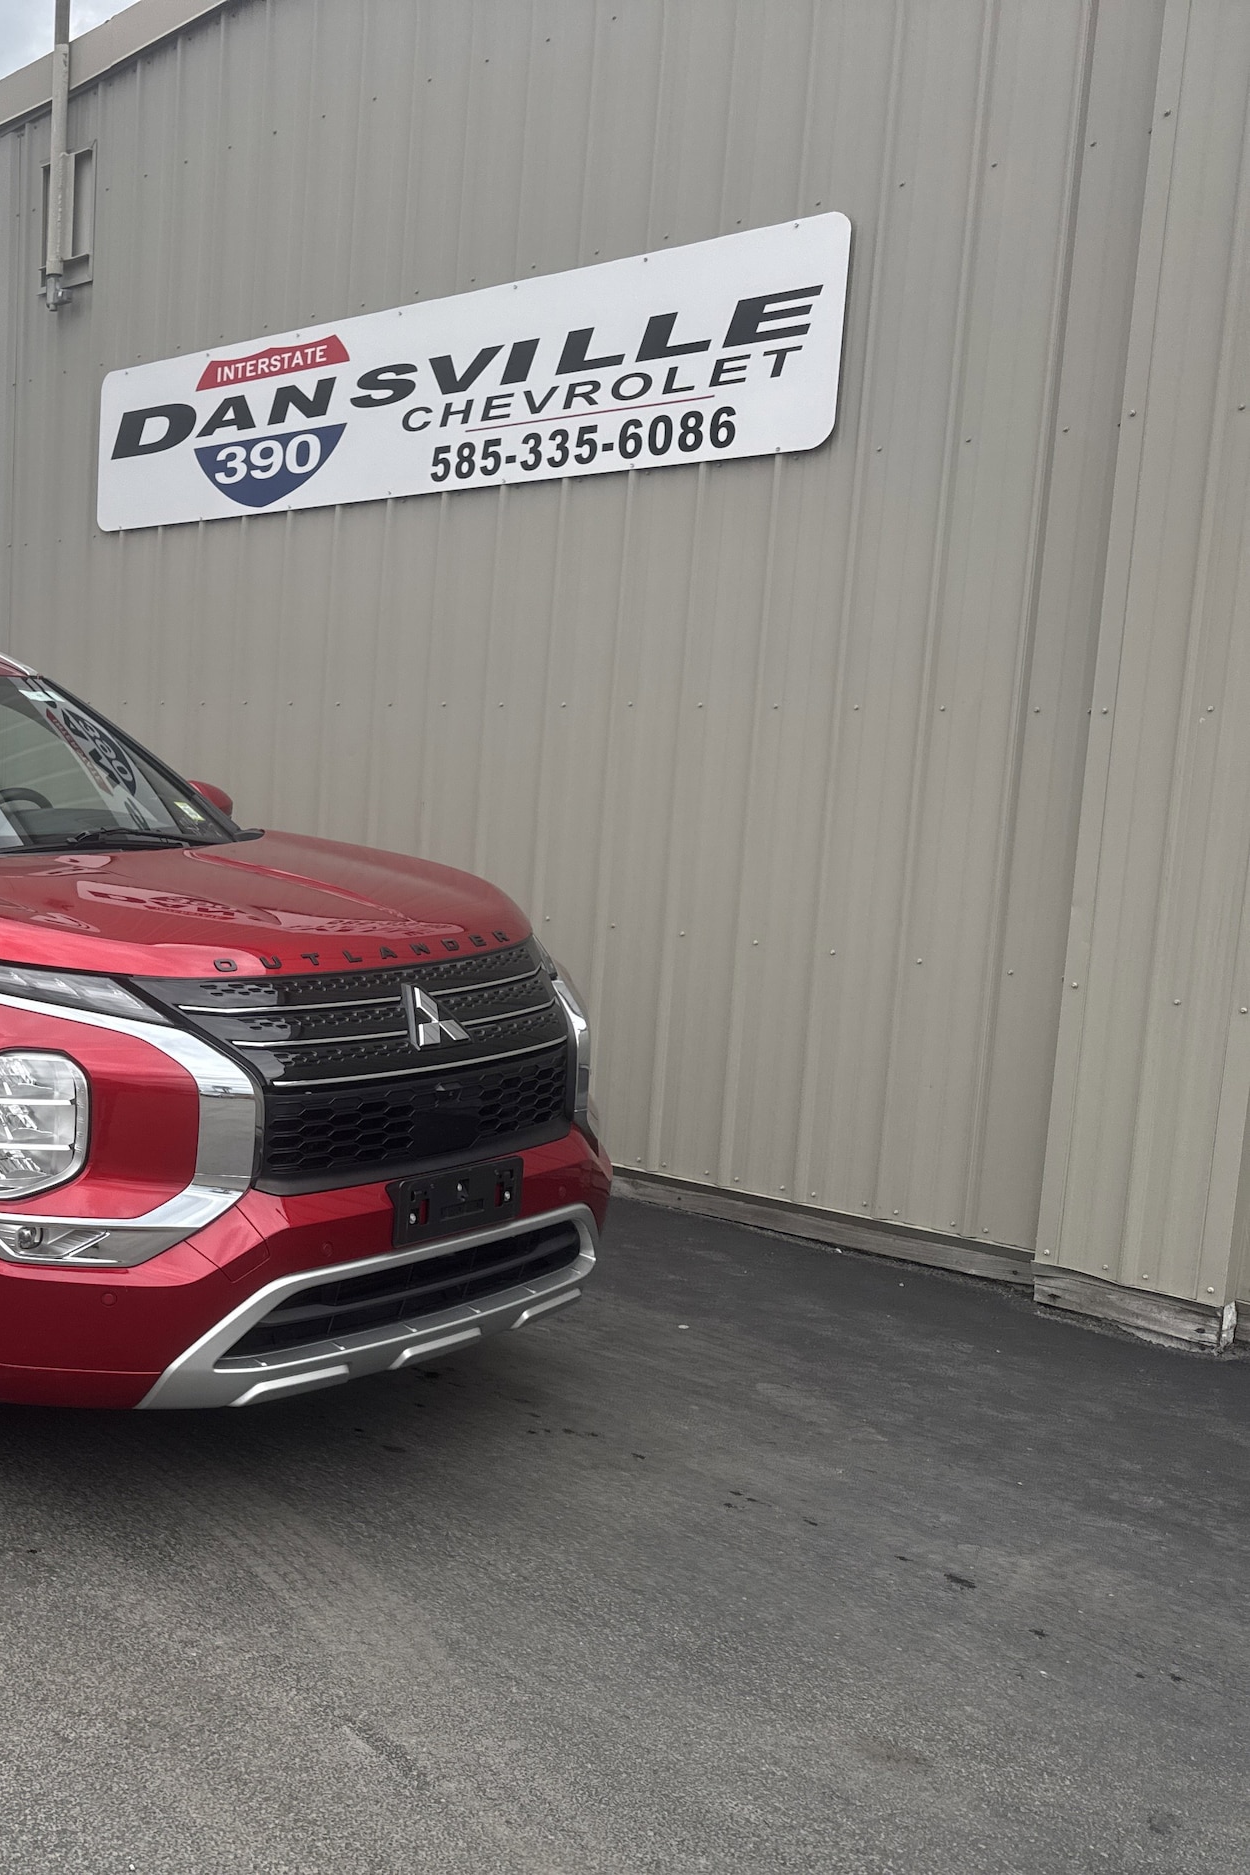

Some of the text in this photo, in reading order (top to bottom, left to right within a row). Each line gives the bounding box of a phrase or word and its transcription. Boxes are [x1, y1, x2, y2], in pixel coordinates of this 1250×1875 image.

[111, 285, 824, 460] DANSVILLE
[216, 345, 328, 383] INTERSTATE
[401, 345, 803, 432] CHEVROLET
[214, 433, 322, 485] 390
[430, 406, 737, 482] 585-335-6086
[213, 930, 511, 973] OUTLANDER
